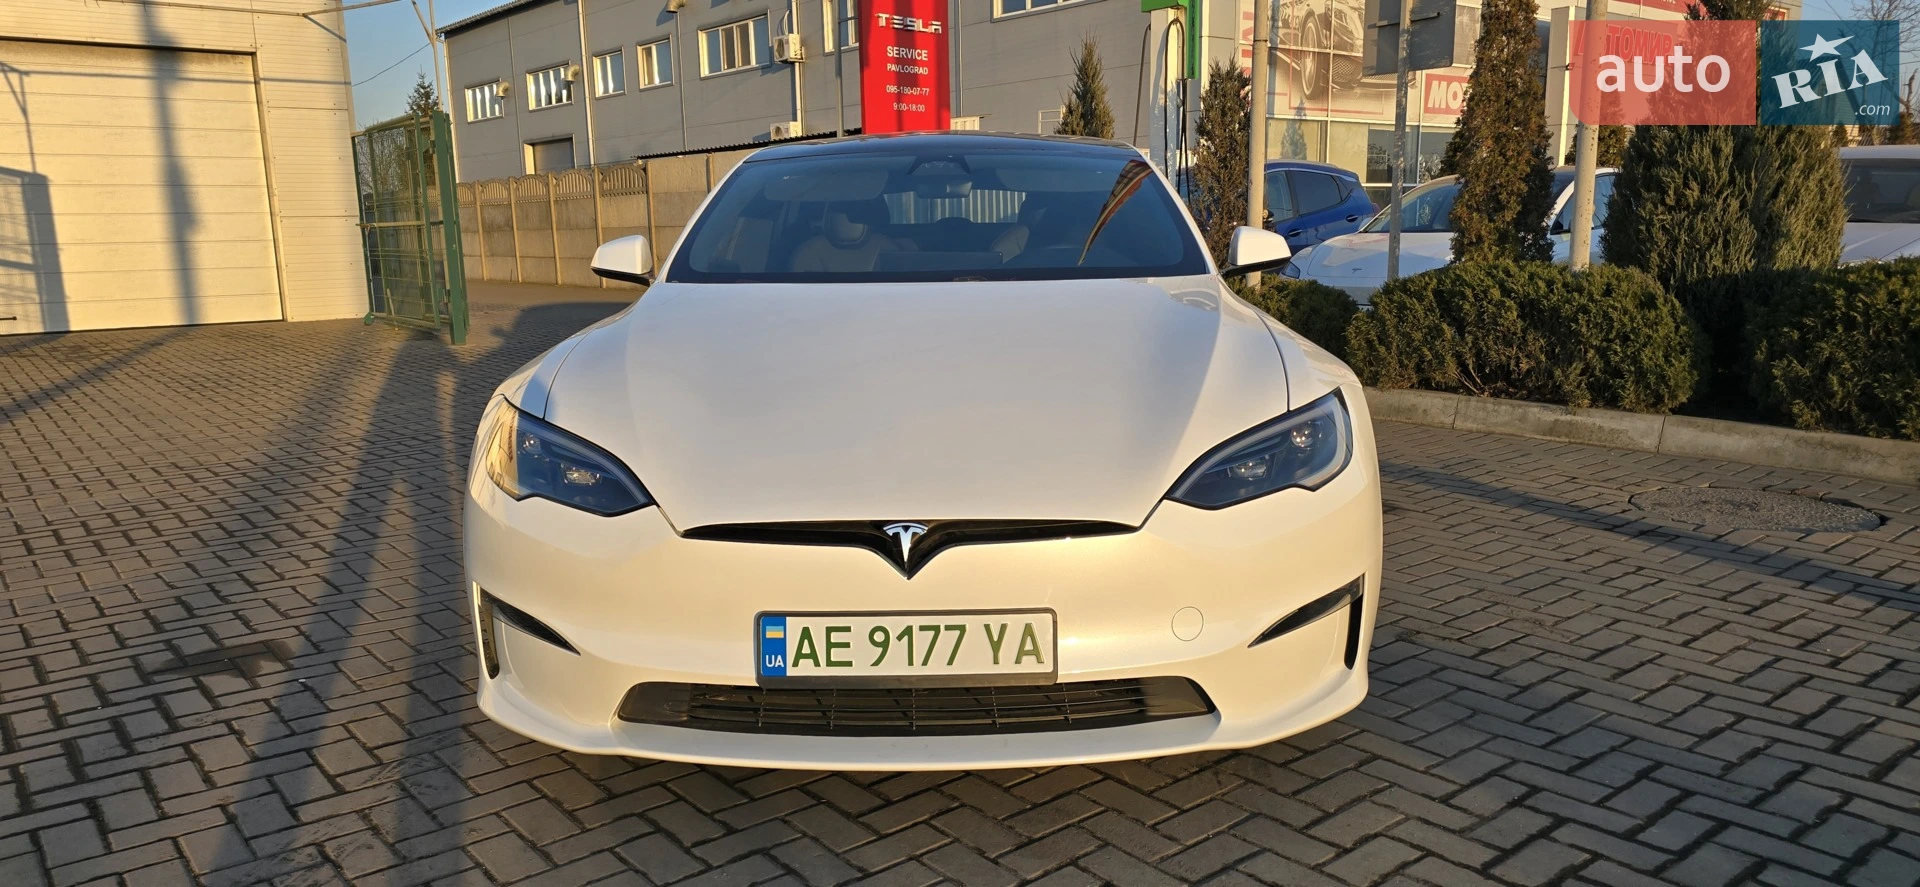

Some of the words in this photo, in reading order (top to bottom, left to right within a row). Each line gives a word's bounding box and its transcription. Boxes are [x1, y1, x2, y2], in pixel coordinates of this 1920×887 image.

[875, 13, 942, 34] TESLA
[1574, 20, 1673, 64] ТОМИР
[886, 46, 928, 60] SERVICE
[886, 63, 929, 75] PAVLOGRAD
[893, 102, 925, 112] 9:00-18:00
[791, 625, 854, 668] AE
[867, 623, 968, 667] 9177
[983, 621, 1046, 665] YA
[765, 654, 785, 668] UA
